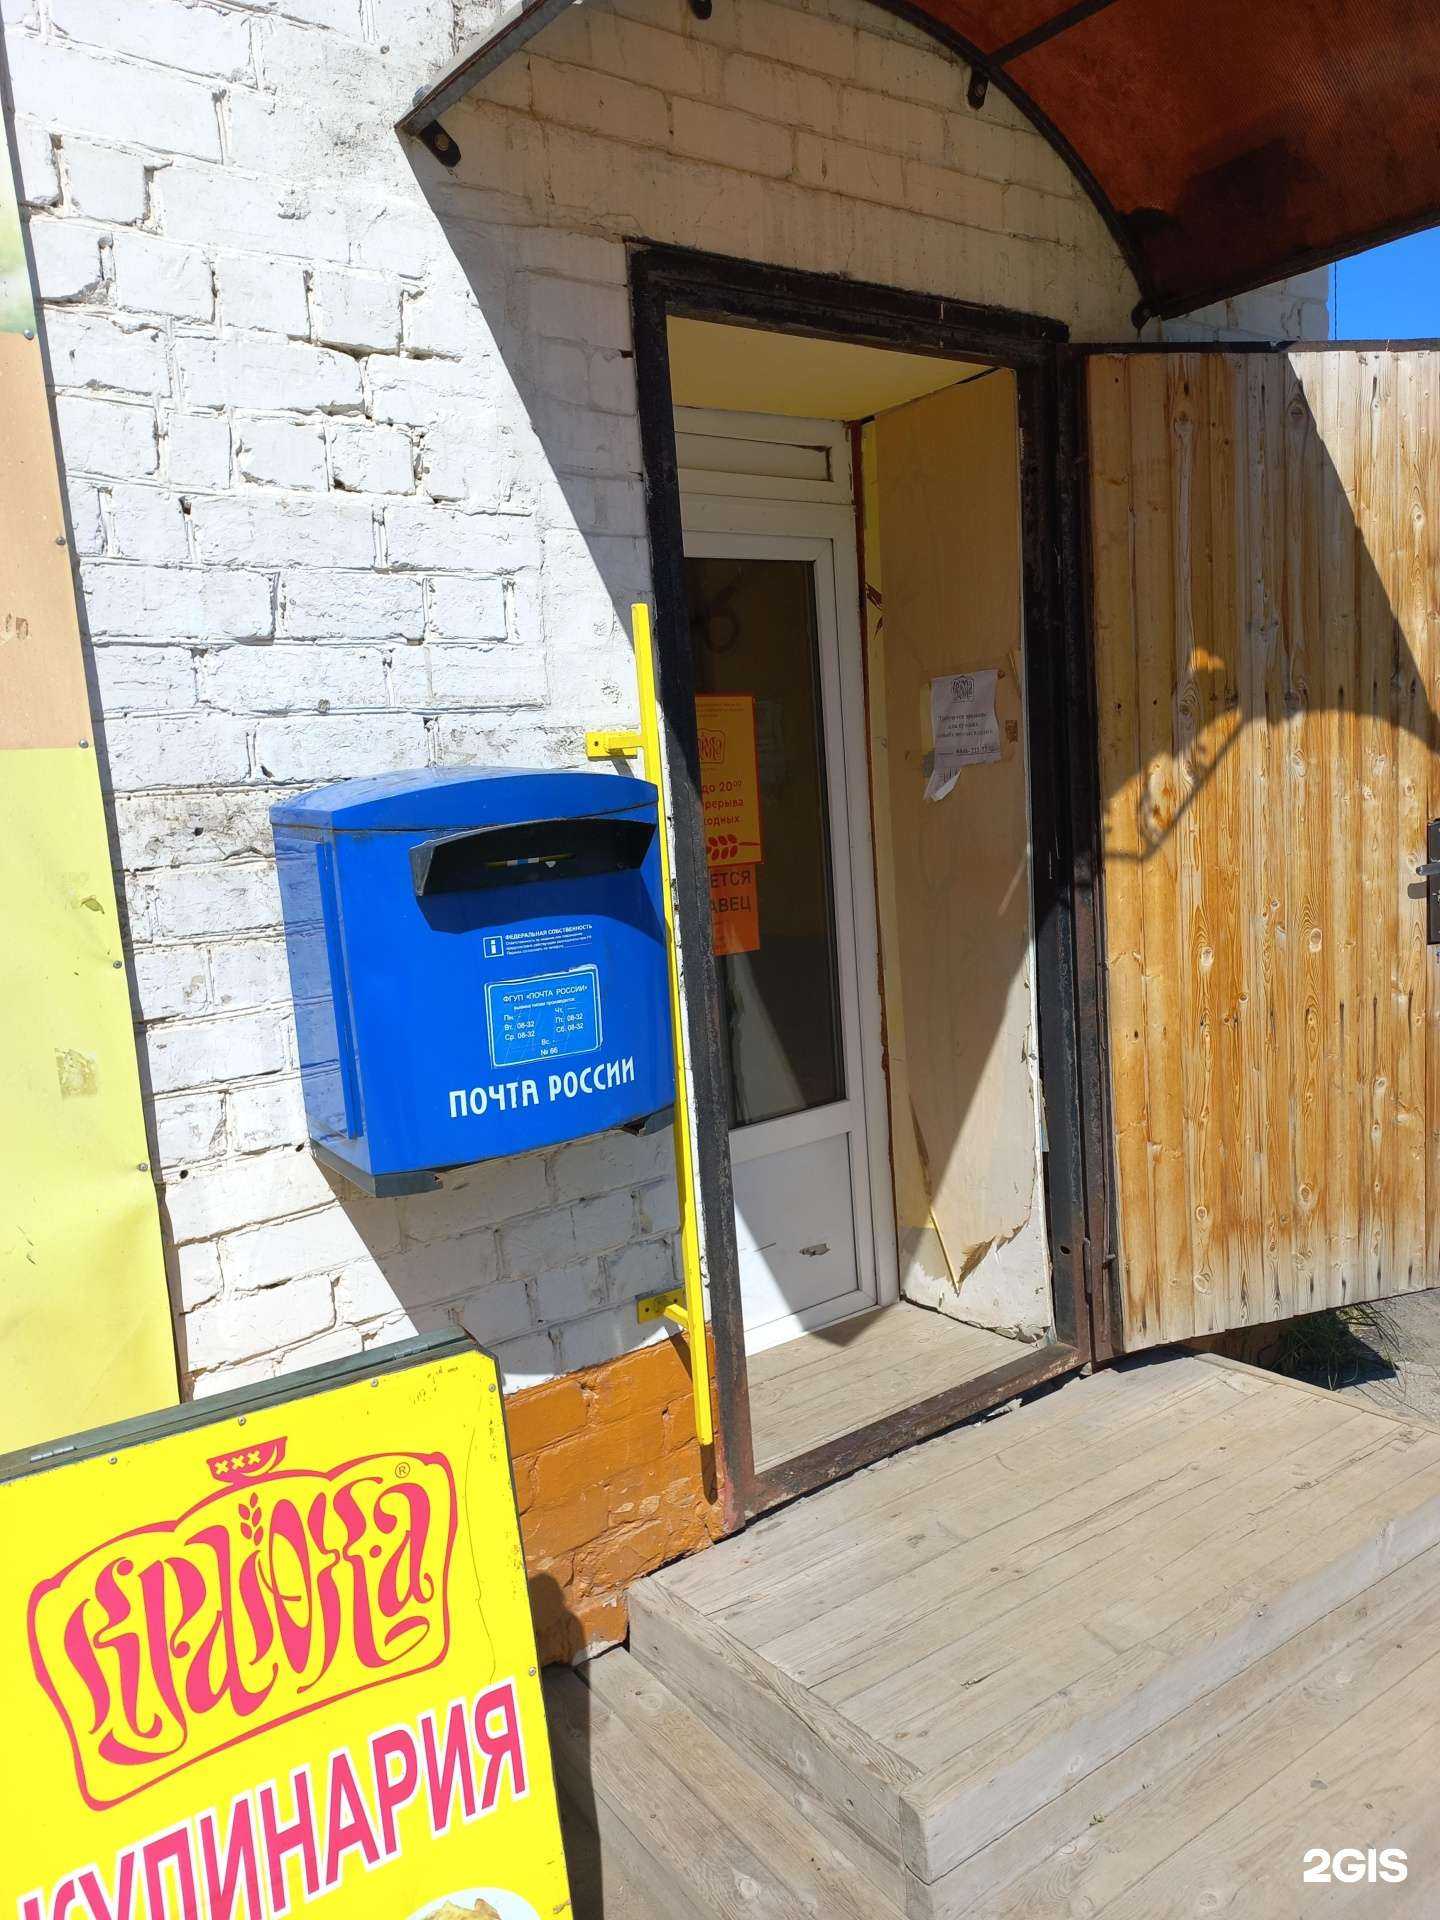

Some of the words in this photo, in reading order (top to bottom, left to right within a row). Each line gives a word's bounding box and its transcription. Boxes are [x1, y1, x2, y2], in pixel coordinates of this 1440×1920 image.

[711, 870, 751, 888] ЕТСЯ
[503, 995, 523, 1003] ФГУП
[449, 1079, 540, 1118] ПОЧТА
[549, 1056, 635, 1102] РОССИИ
[23, 1683, 525, 1919] УЛИНАРИЯ
